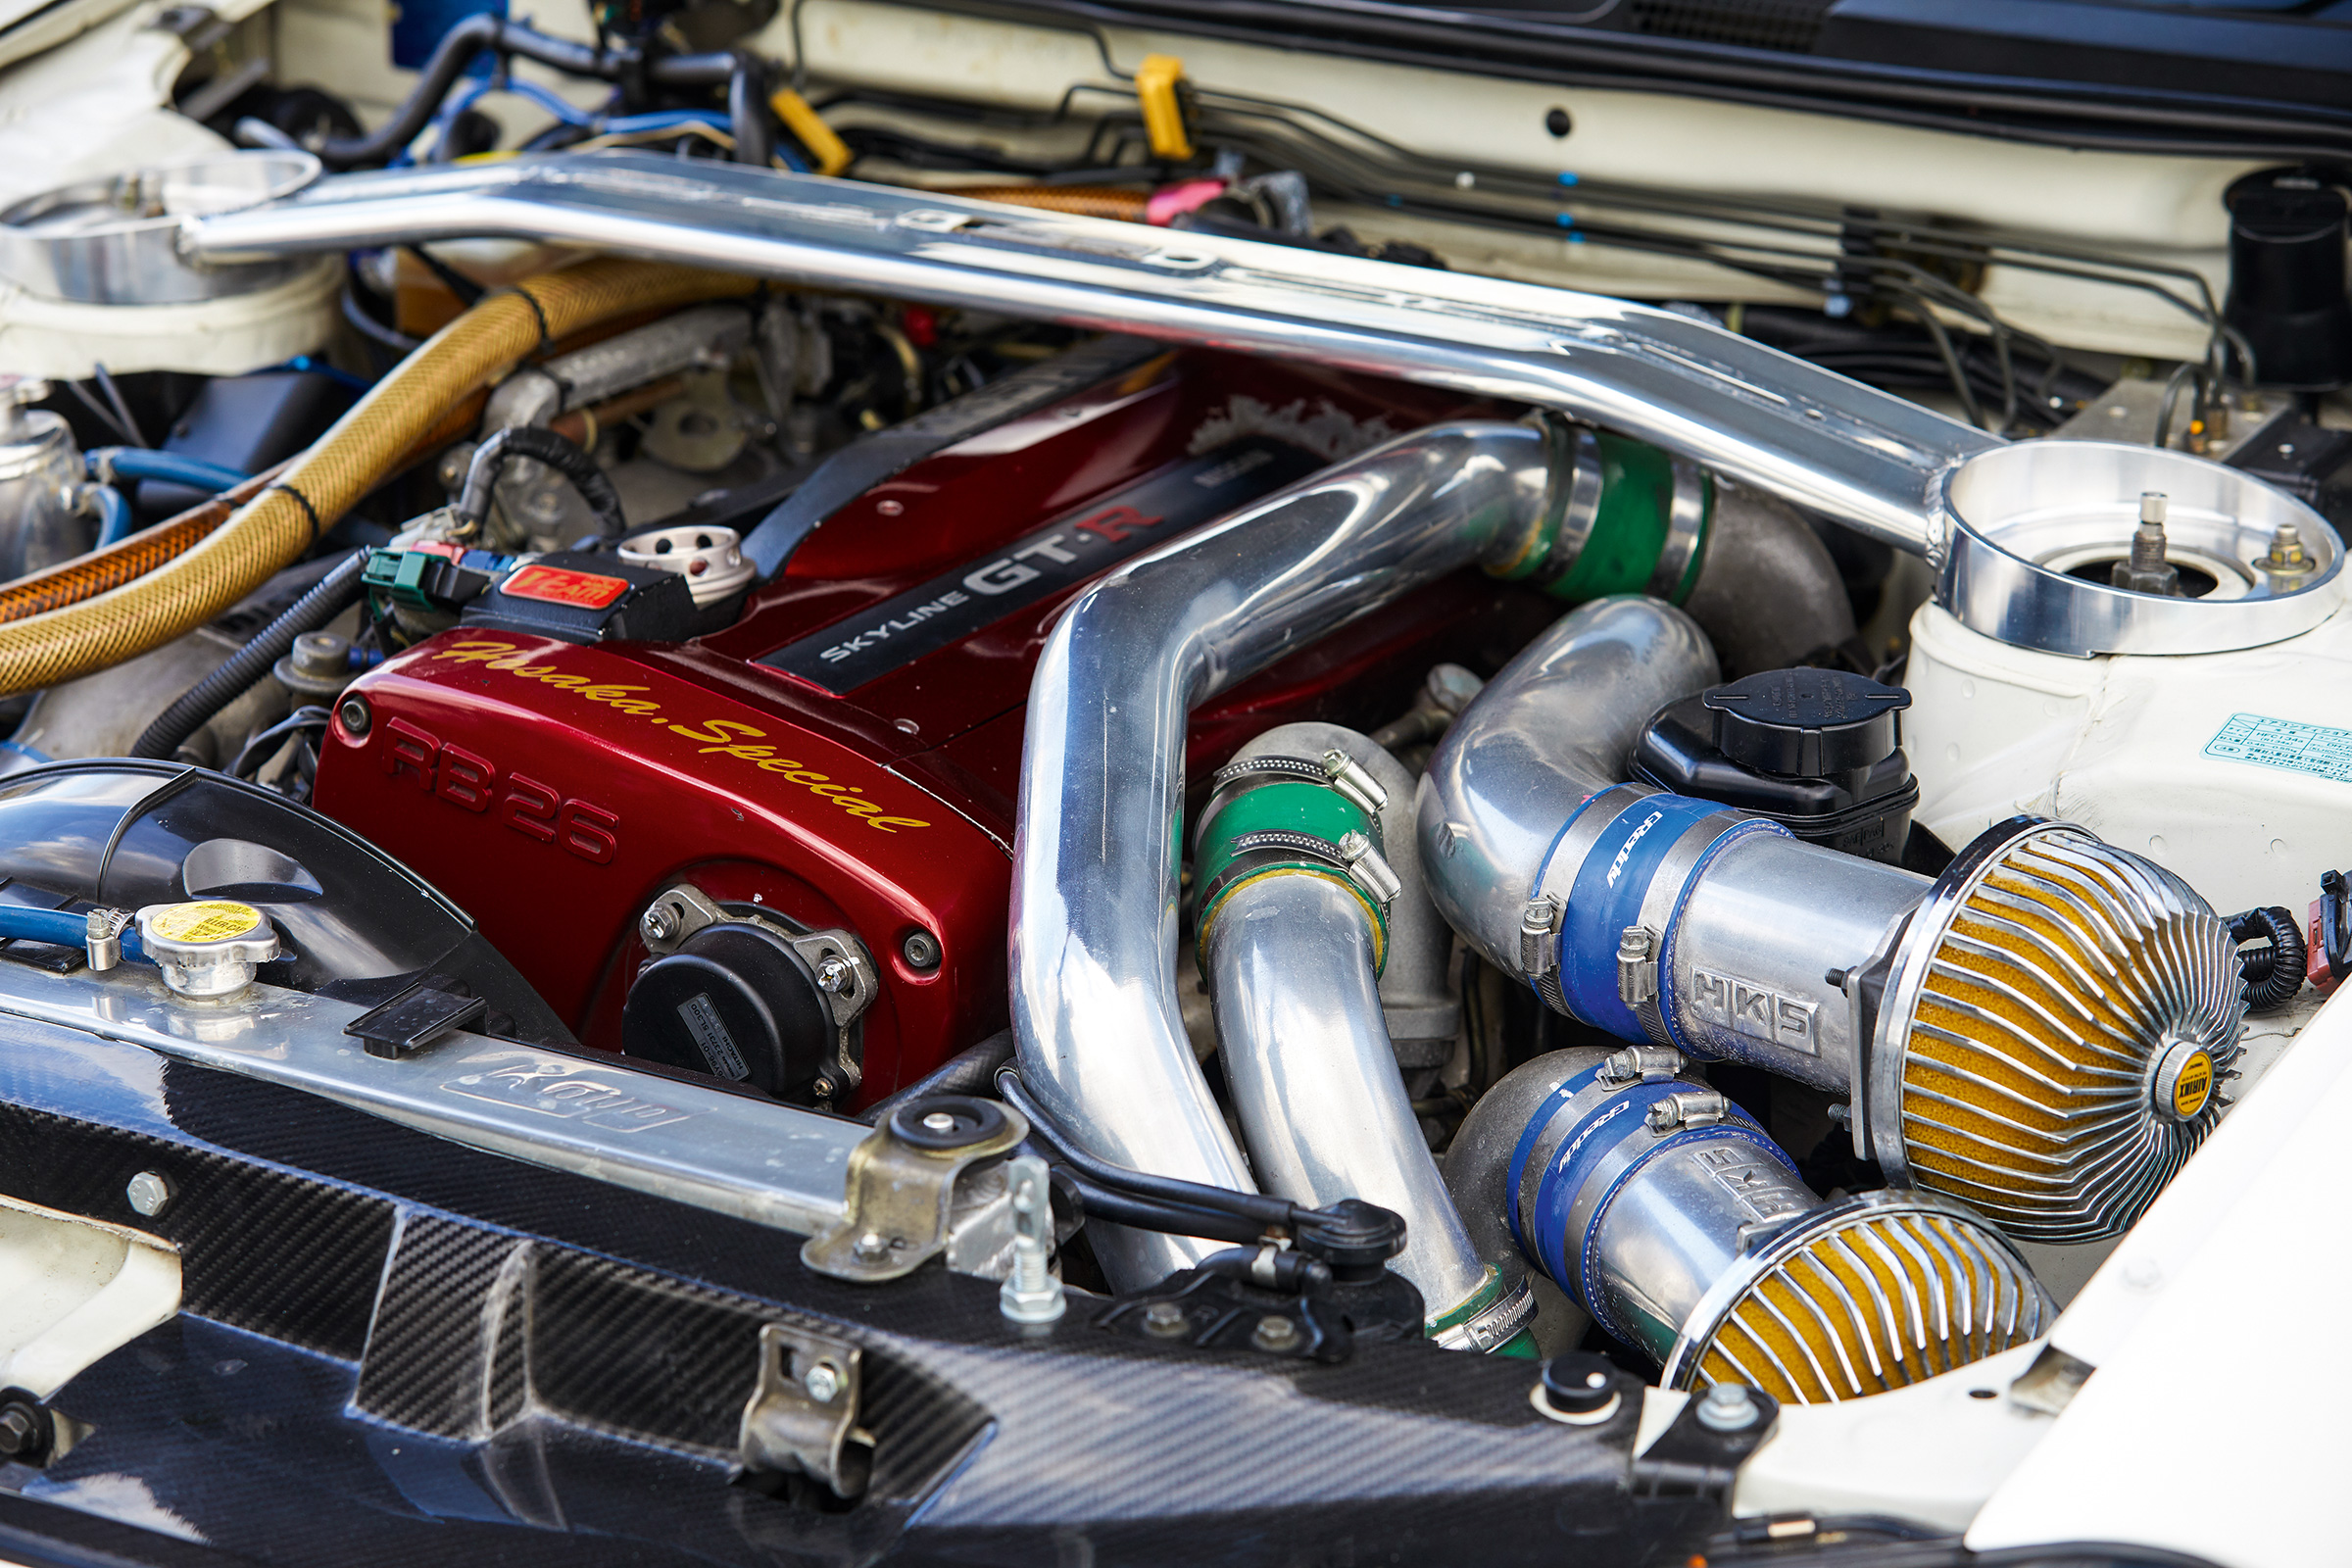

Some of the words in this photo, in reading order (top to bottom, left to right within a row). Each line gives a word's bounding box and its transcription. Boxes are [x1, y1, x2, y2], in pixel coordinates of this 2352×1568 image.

[819, 590, 970, 663] SKYLINE
[690, 1004, 710, 1031] 5L300
[1692, 968, 1811, 1043] HKS
[707, 1032, 724, 1055] 23731
[721, 1036, 744, 1070] HITACHI
[2178, 1076, 2208, 1099] AIRINX
[1698, 1146, 1798, 1215] HKS
